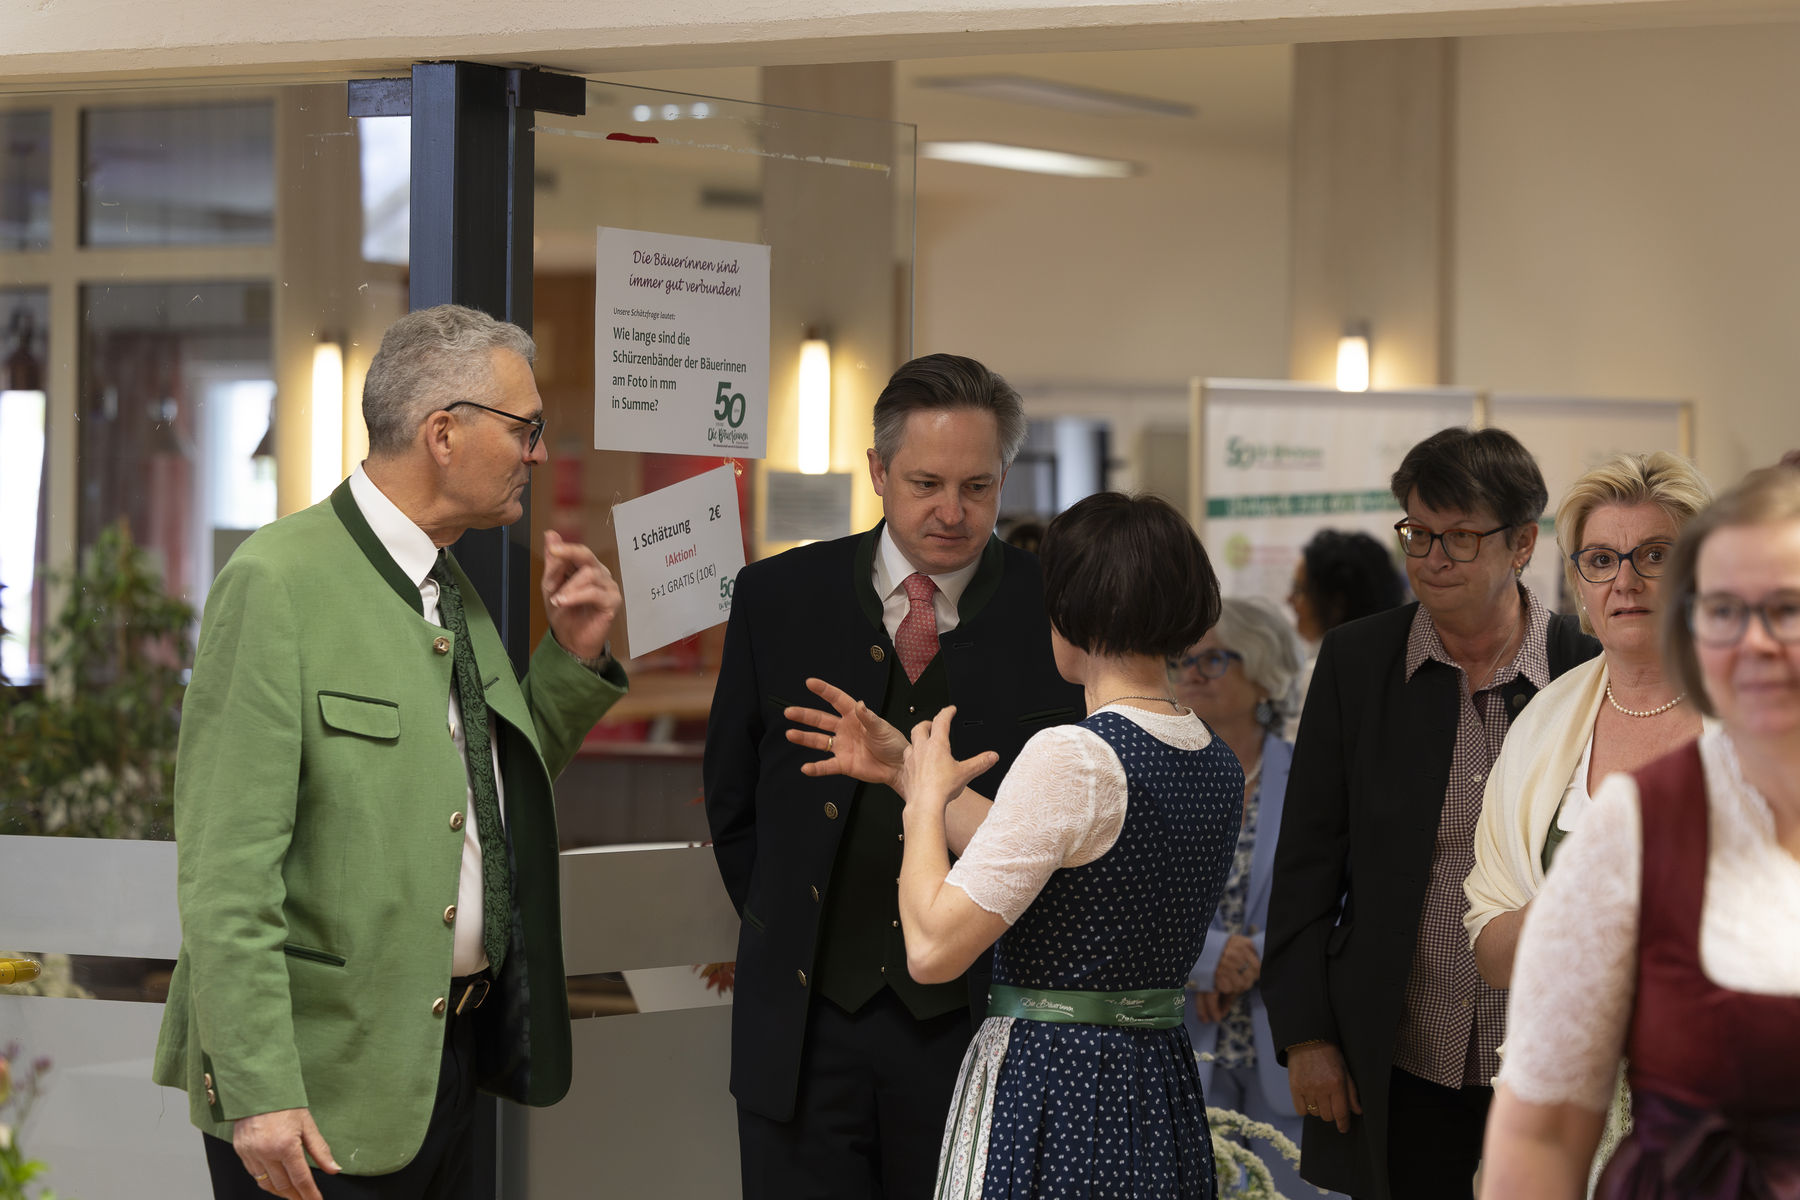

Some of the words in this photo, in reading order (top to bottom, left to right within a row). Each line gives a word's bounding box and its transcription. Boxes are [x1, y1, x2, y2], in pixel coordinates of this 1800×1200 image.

[633, 251, 652, 264] Die
[654, 254, 715, 272] Bäuerinnen
[716, 260, 740, 274] sind
[629, 274, 663, 289] immer
[665, 278, 685, 295] gut
[686, 280, 741, 297] verbunden!
[613, 308, 630, 316] Unsere
[631, 309, 659, 320] Schätzfrage
[660, 311, 675, 320] lautet:
[613, 327, 630, 341] Wie
[632, 328, 657, 346] lange
[658, 331, 676, 344] sind
[678, 332, 690, 345] die
[613, 351, 682, 368] Schürzenbänder
[684, 355, 698, 369] der
[700, 357, 747, 373] Bäuerinnen
[612, 375, 626, 387] am
[628, 374, 648, 388] Foto
[650, 376, 658, 388] in
[660, 378, 676, 390] mm
[612, 396, 620, 409] in
[622, 397, 659, 411] Summe?
[714, 381, 746, 428] 50
[633, 536, 639, 551] 1
[641, 519, 691, 547] Schätzung
[709, 505, 722, 521] 2€
[665, 545, 697, 567] !Aktion!
[651, 584, 666, 600] 5+1
[667, 572, 695, 594] GRATIS
[697, 565, 717, 584] (10€)
